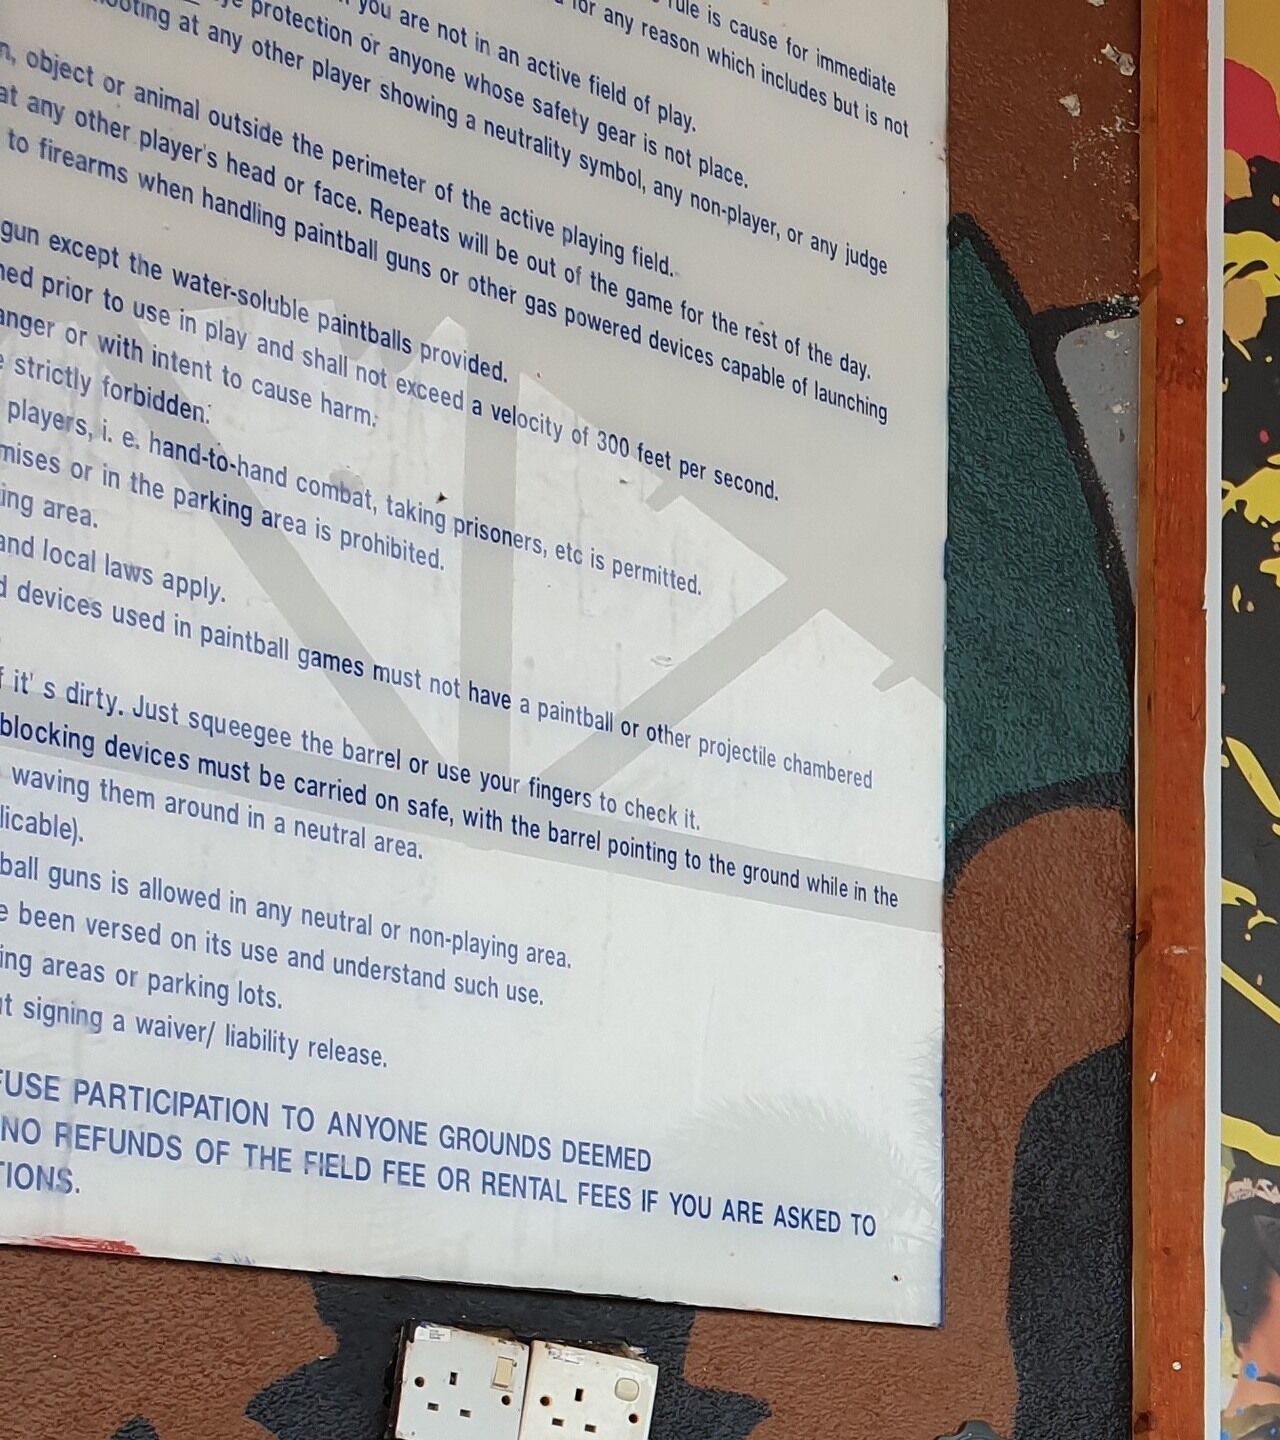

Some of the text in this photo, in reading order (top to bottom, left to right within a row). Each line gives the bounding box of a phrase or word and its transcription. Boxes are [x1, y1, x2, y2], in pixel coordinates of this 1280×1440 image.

[251, 0, 748, 189] protection anyone whose safety gear place.
[527, 56, 696, 134] active field play.
[604, 8, 859, 119] any reason which includes but
[730, 19, 896, 96] cause for immediate
[26, 49, 674, 277] object animal outside perimeter active playing field.
[252, 39, 887, 276] other player showing neutrality symbol, non-player, judge
[38, 137, 887, 425] firearms when handling paintball guns other powered devices capable launching
[75, 109, 870, 381] other player's head face. Repeats will game rest day.
[49, 234, 507, 383] except water-soluble paintballs provided.
[14, 354, 91, 397] strictly
[42, 275, 778, 501] prior play shall exceed velocity feet second.
[97, 335, 312, 409] with intent cause
[8, 397, 701, 595] players, hand-to-hand combat, taking prisoners, permitted.
[43, 499, 97, 528] area.
[174, 487, 444, 570] parking area prohibited.
[43, 538, 225, 605] local laws apply.
[17, 580, 872, 789] devices used paintball games must have paintball other projectile chambered
[66, 681, 677, 826] dirty. Just squeegee barrel your fingers check
[12, 766, 422, 859] waving them around neutral area.
[105, 734, 848, 897] devices must carried safe, with barrel pointing ground while
[19, 901, 543, 1005] been versed understand such use.
[48, 866, 571, 968] guns allowed neutral non-playing area.
[23, 1001, 387, 1068] signing waiver/ liability release.
[42, 957, 282, 1009] areas parking lots.
[55, 1122, 841, 1233] REFUNDS FIELD RENTAL FEES ASKED
[73, 1079, 651, 1172] PARTICIPATION ANYONE GROUNDS DEEMED
